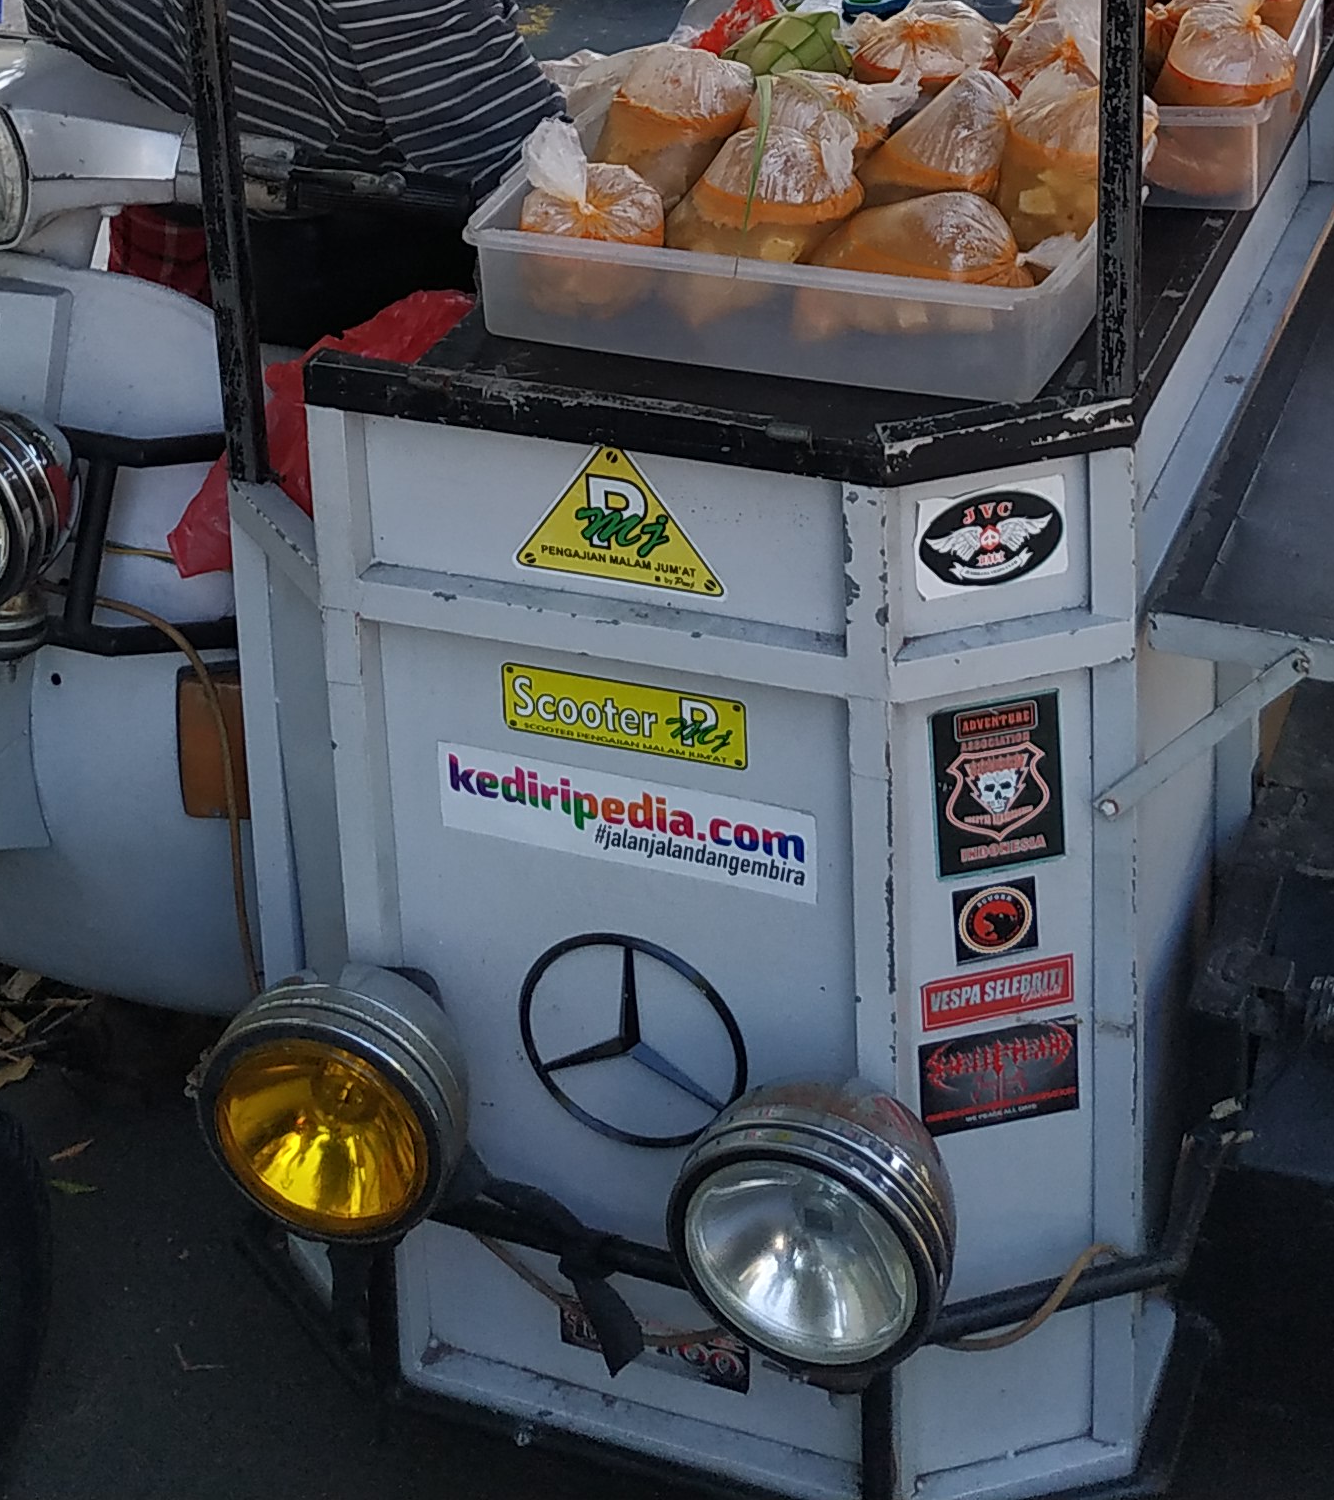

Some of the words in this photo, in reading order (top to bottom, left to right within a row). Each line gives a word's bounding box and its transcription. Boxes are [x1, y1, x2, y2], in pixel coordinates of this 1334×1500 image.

[962, 501, 1014, 525] JVC
[540, 544, 607, 563] PENGAJIAN
[609, 555, 652, 571] MALAM
[654, 562, 697, 578] JUM'AT
[512, 675, 658, 738] Scooter
[961, 709, 1031, 733] ADVENTURE
[524, 722, 575, 738] SCOOTER
[577, 731, 640, 749] PENGAJIAN
[642, 742, 686, 757] MALAM
[688, 751, 728, 764] JUM'AT
[448, 752, 806, 863] kediripedia.com
[594, 823, 807, 887] #jalanjalandangembira
[960, 834, 1047, 863] INDONESIA
[930, 986, 981, 1013] VESPA
[984, 968, 1064, 1003] SELEBRITI
